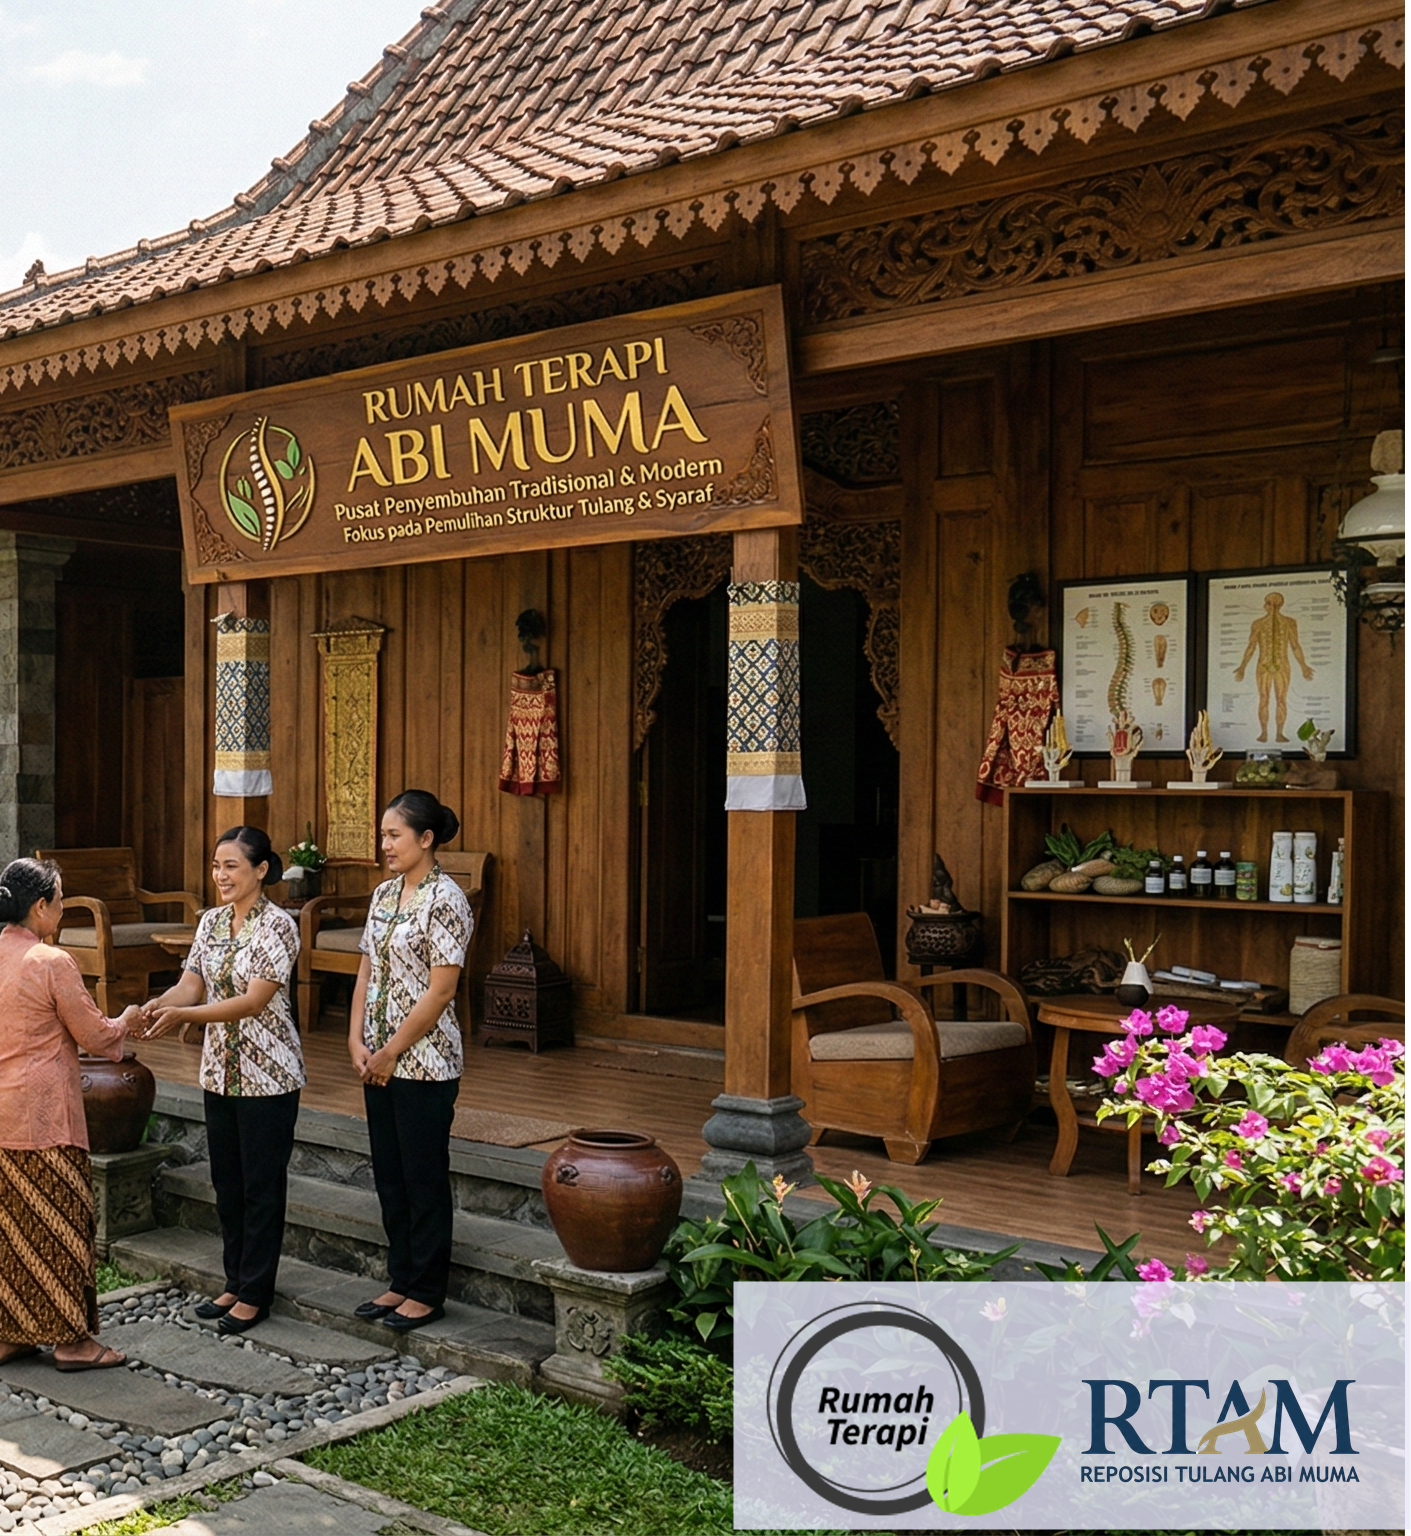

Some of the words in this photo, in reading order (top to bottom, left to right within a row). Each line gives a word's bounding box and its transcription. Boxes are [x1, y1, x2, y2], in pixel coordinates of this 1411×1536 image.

[363, 367, 505, 425] RUMAH
[514, 337, 667, 397] TERAPI
[347, 422, 451, 492] ABI
[471, 384, 707, 475] MUMA
[335, 500, 381, 522] Pusat
[384, 484, 506, 520] Penyembuhan
[510, 468, 614, 502] Tradisional
[620, 465, 635, 485] &
[639, 453, 722, 484] Modern
[343, 523, 384, 543] Fokus
[388, 520, 423, 541] pada
[425, 509, 503, 534] Pemulihan
[507, 501, 575, 523] Struktur
[578, 495, 635, 520] Tulang
[638, 491, 652, 508] &
[655, 482, 713, 509] Syaraf
